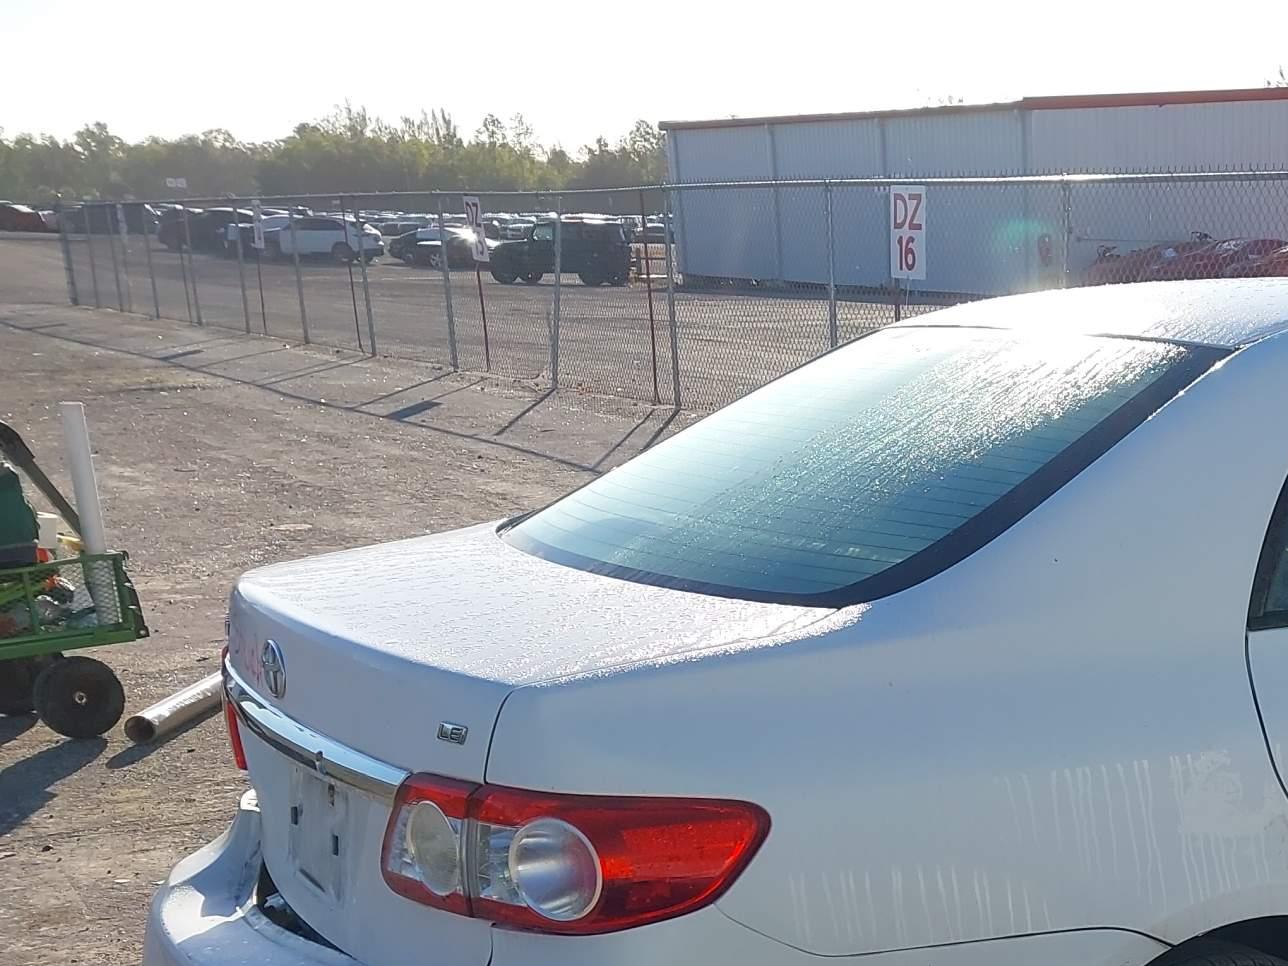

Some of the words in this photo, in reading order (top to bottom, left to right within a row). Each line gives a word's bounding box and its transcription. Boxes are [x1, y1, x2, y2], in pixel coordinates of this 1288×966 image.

[893, 193, 922, 230] DZ
[896, 235, 916, 271] 16
[438, 722, 466, 744] LE
